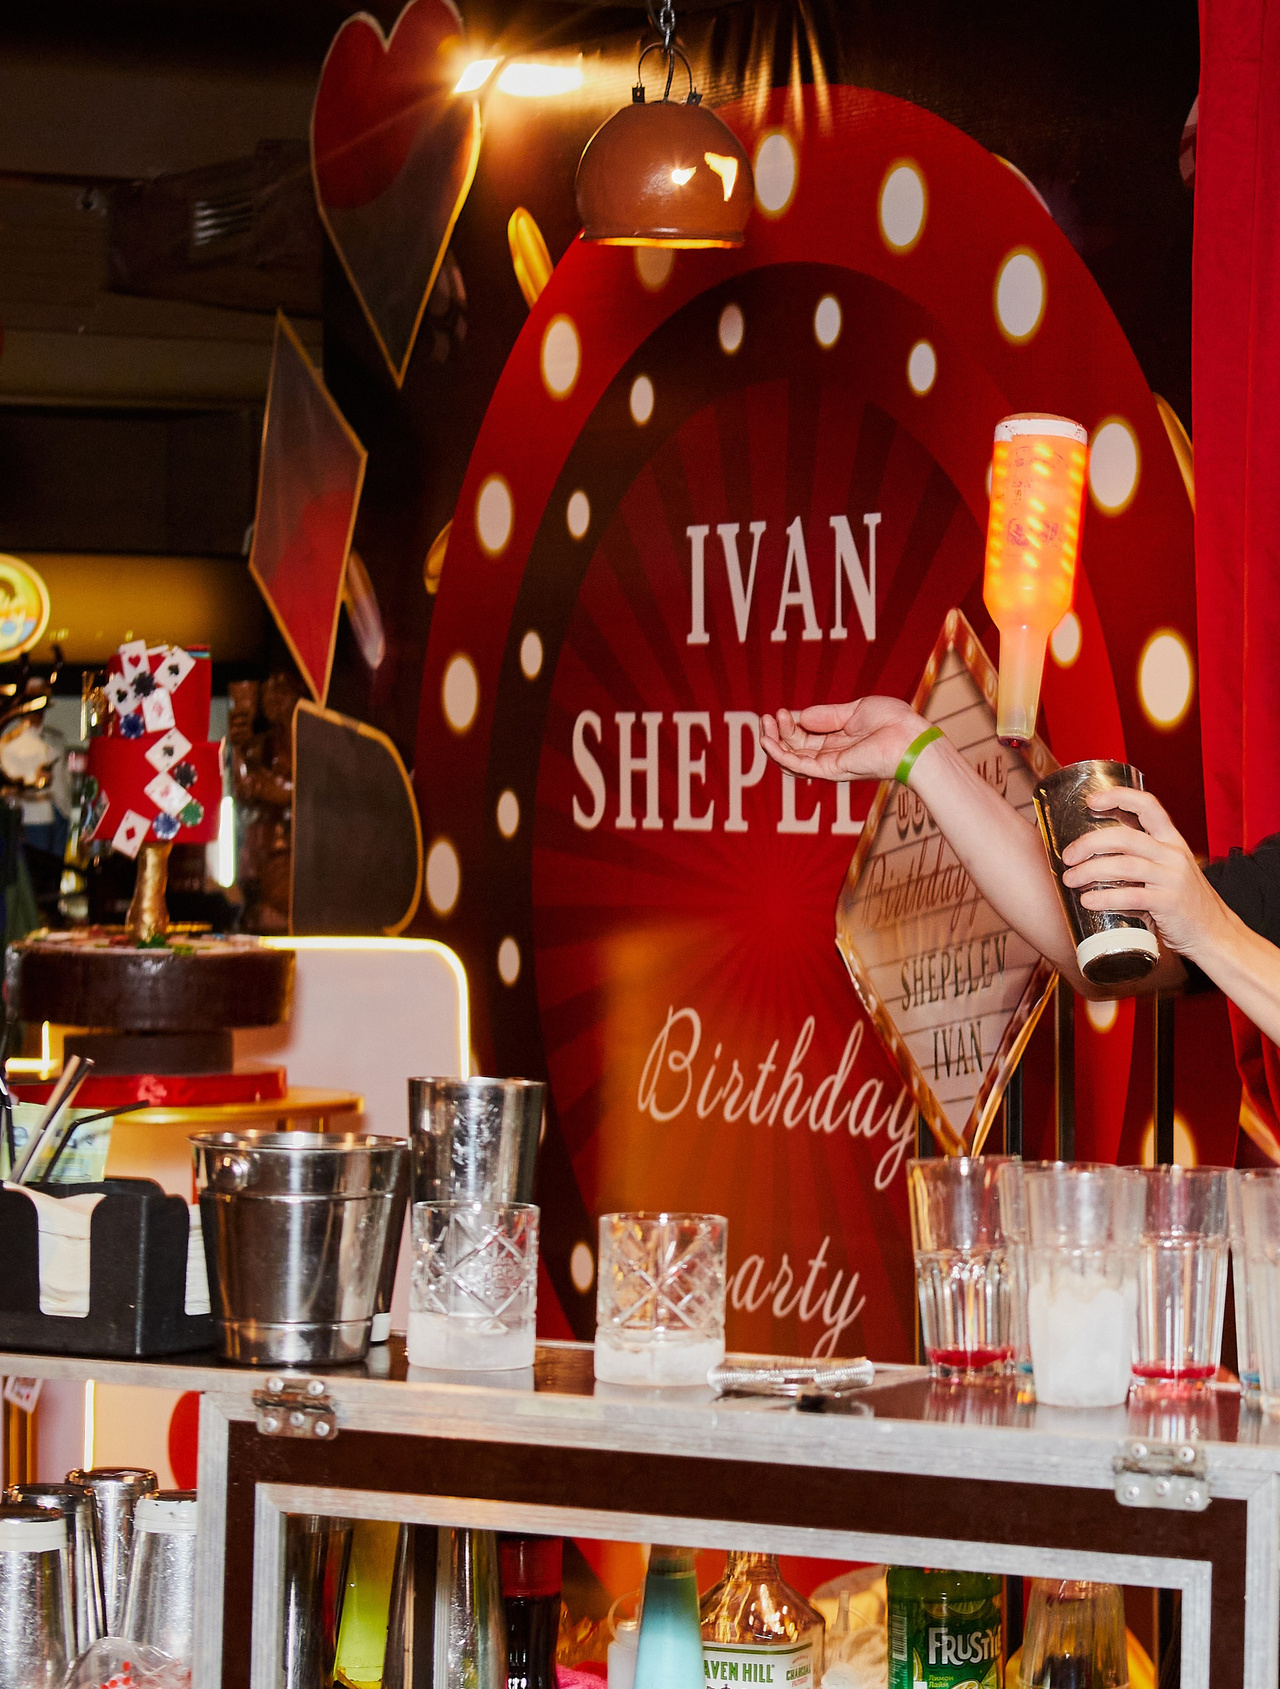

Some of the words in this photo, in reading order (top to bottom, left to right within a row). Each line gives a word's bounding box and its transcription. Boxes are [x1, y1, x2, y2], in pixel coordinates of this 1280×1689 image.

[686, 512, 882, 646] IVAN
[901, 935, 1008, 1011] SHEPELEV
[637, 1005, 918, 1190] Birthday
[934, 1021, 983, 1079] IVAN
[726, 1236, 866, 1360] arty
